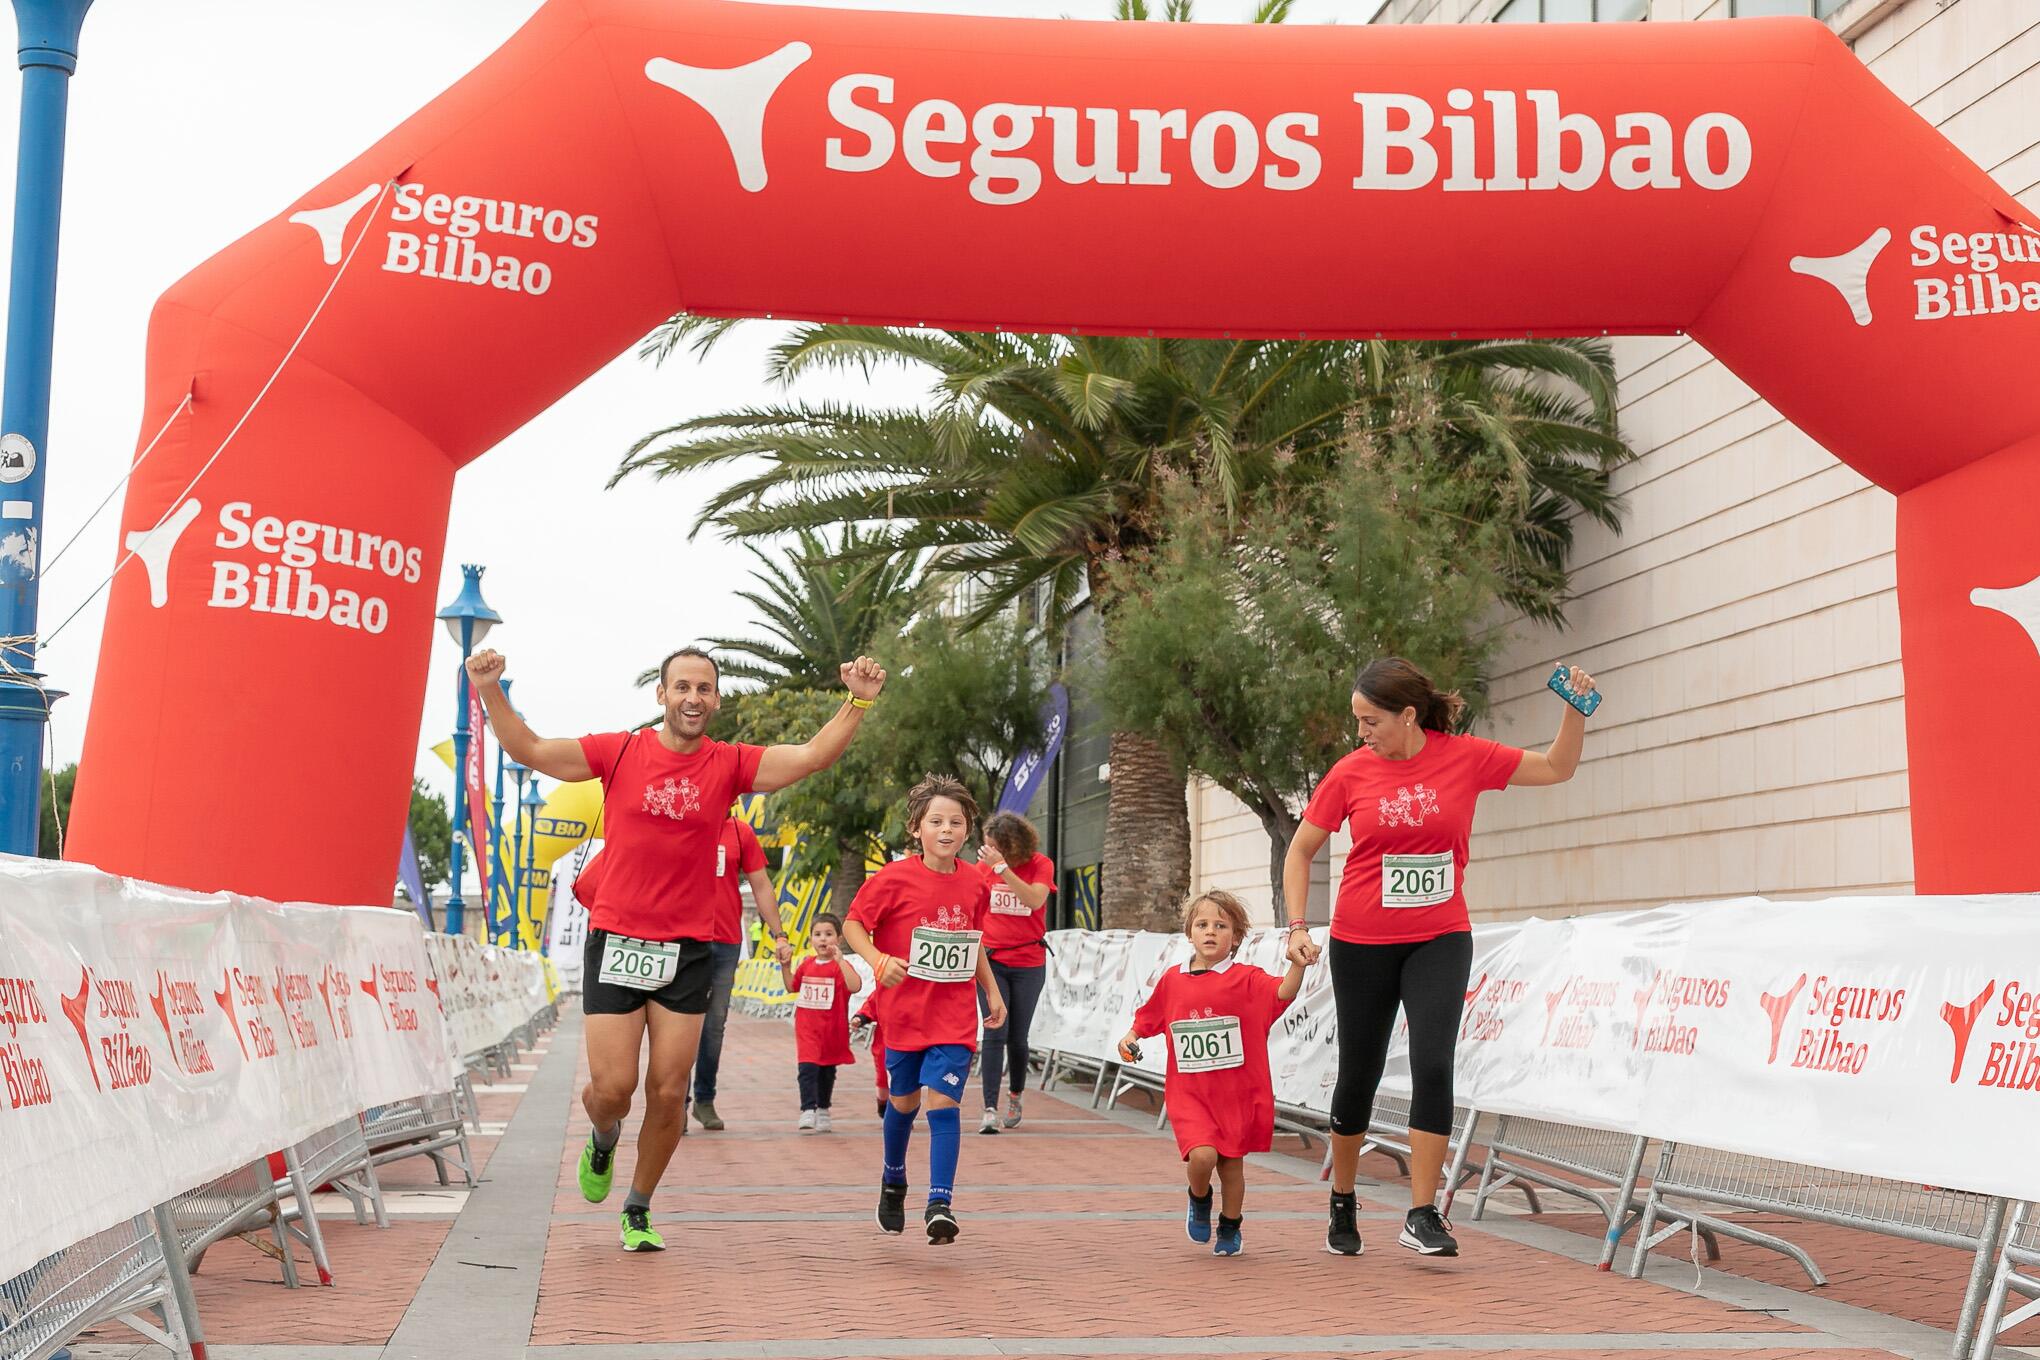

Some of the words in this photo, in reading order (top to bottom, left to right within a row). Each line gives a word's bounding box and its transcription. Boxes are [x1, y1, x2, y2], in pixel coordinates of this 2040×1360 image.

[826, 72, 1322, 206] Seguros
[1352, 88, 1753, 192] Bilbao
[390, 183, 600, 249] Seguros
[381, 231, 552, 296] Bilbao
[214, 501, 423, 584] Seguros
[207, 559, 389, 634] Bilbao
[554, 821, 584, 837] BM
[995, 893, 1025, 908] 301
[1390, 867, 1446, 895] 2061
[609, 949, 667, 979] 2061
[917, 941, 970, 970] 2061
[1807, 975, 1906, 1027] Seguros
[101, 1032, 152, 1089] Bilbao
[1180, 1030, 1232, 1059] 2061
[1791, 1028, 1868, 1075] Bilbao
